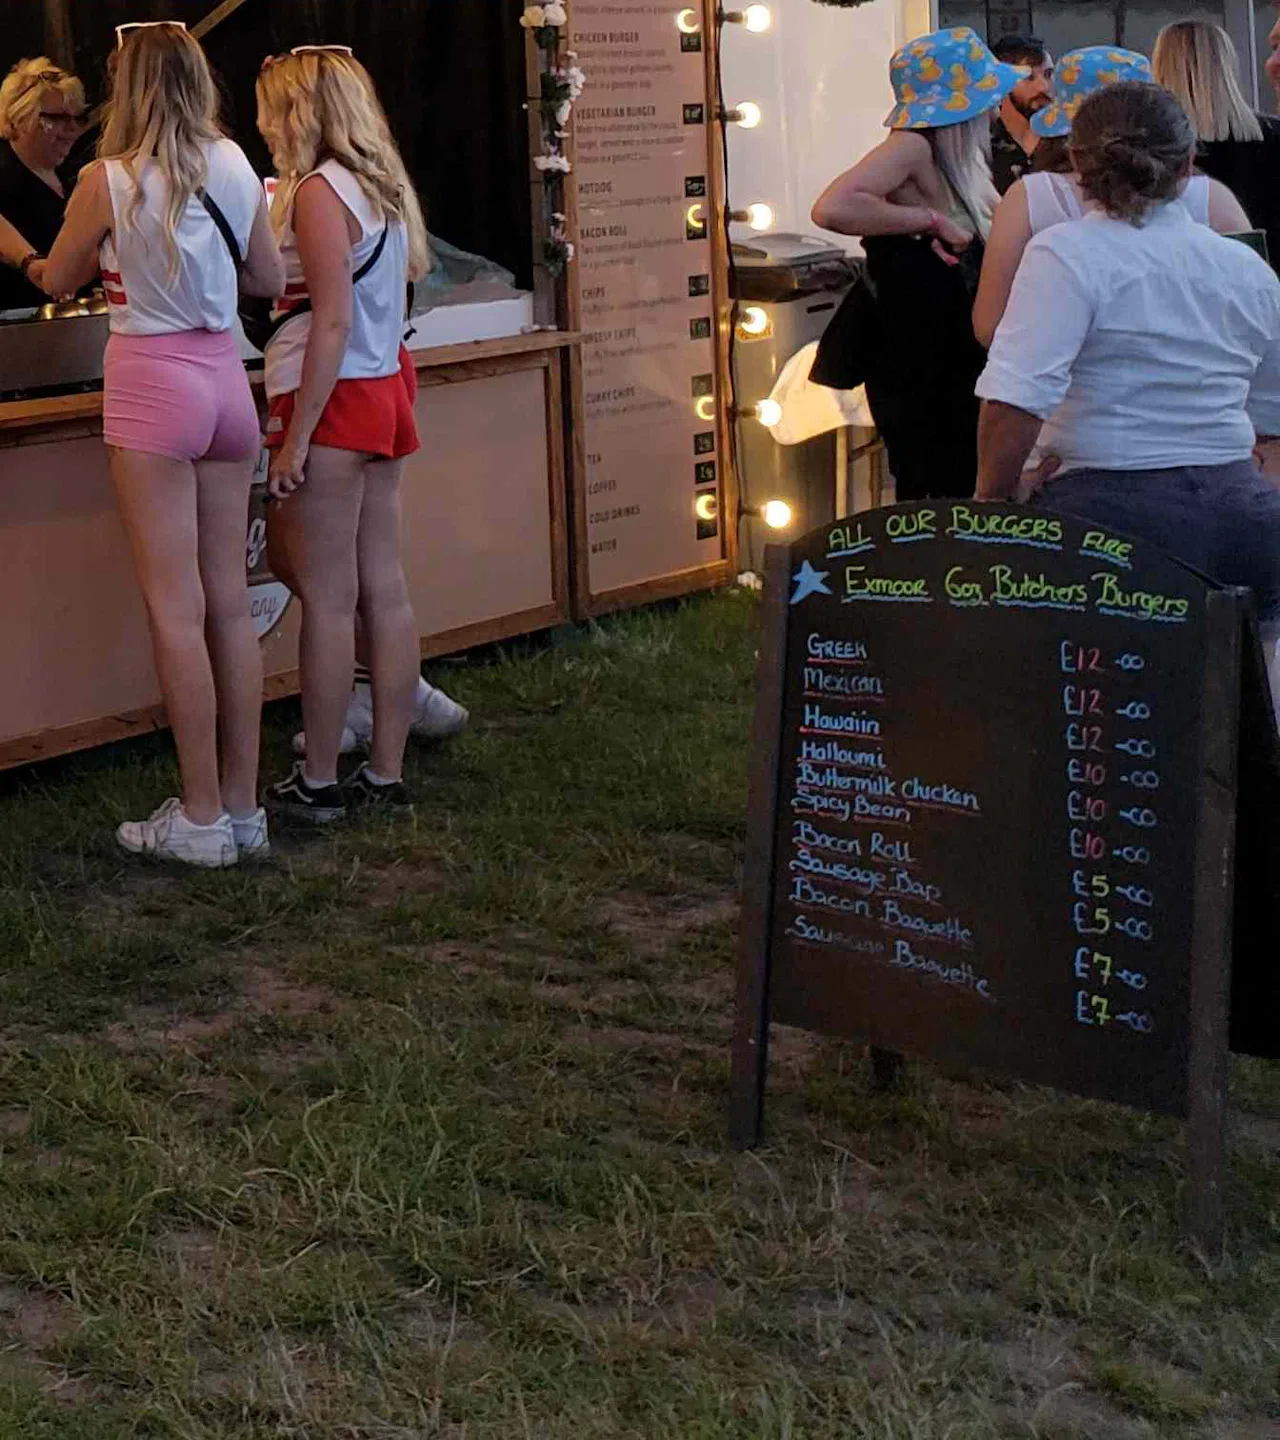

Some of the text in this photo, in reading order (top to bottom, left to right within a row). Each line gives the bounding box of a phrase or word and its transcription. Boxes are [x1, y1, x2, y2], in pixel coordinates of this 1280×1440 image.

[828, 506, 1134, 560] ALL OUR BURGERS ARE
[989, 565, 1089, 601] Butchers
[1090, 572, 1189, 622] Burgers
[804, 667, 884, 694] Mexican
[801, 740, 886, 768] Halloumi
[796, 762, 897, 797] Buttermilk
[791, 788, 911, 823] Spicy Bean
[792, 819, 917, 862] Bacon Roll
[789, 847, 886, 894] Sausage
[789, 875, 872, 918] Bacon
